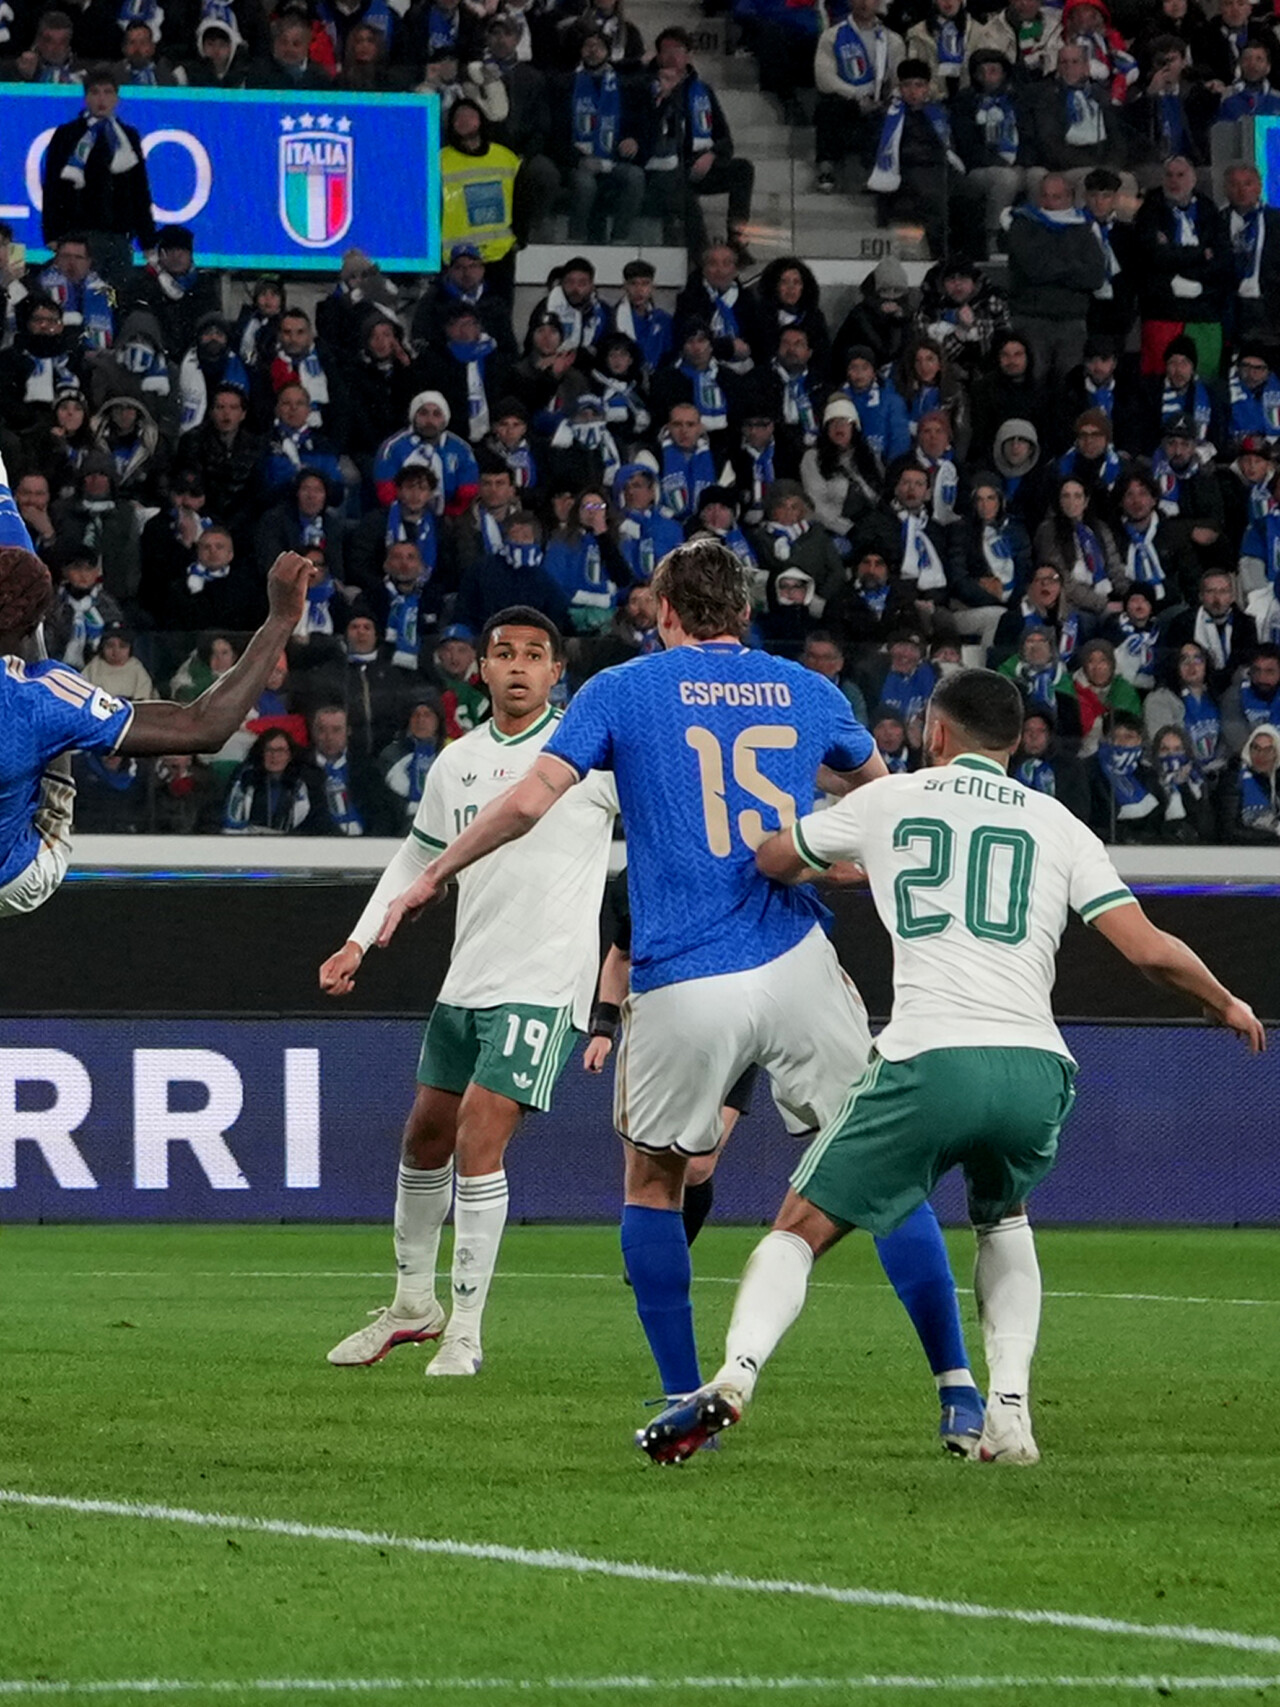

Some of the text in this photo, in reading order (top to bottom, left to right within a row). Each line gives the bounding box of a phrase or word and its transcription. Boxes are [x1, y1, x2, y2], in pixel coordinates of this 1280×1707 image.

[286, 142, 347, 166] ITALIA
[679, 681, 791, 707] ESPOSITO
[685, 725, 798, 858] 15
[924, 775, 1026, 807] SPENCER
[893, 817, 1038, 948] 20
[502, 1013, 549, 1066] 19
